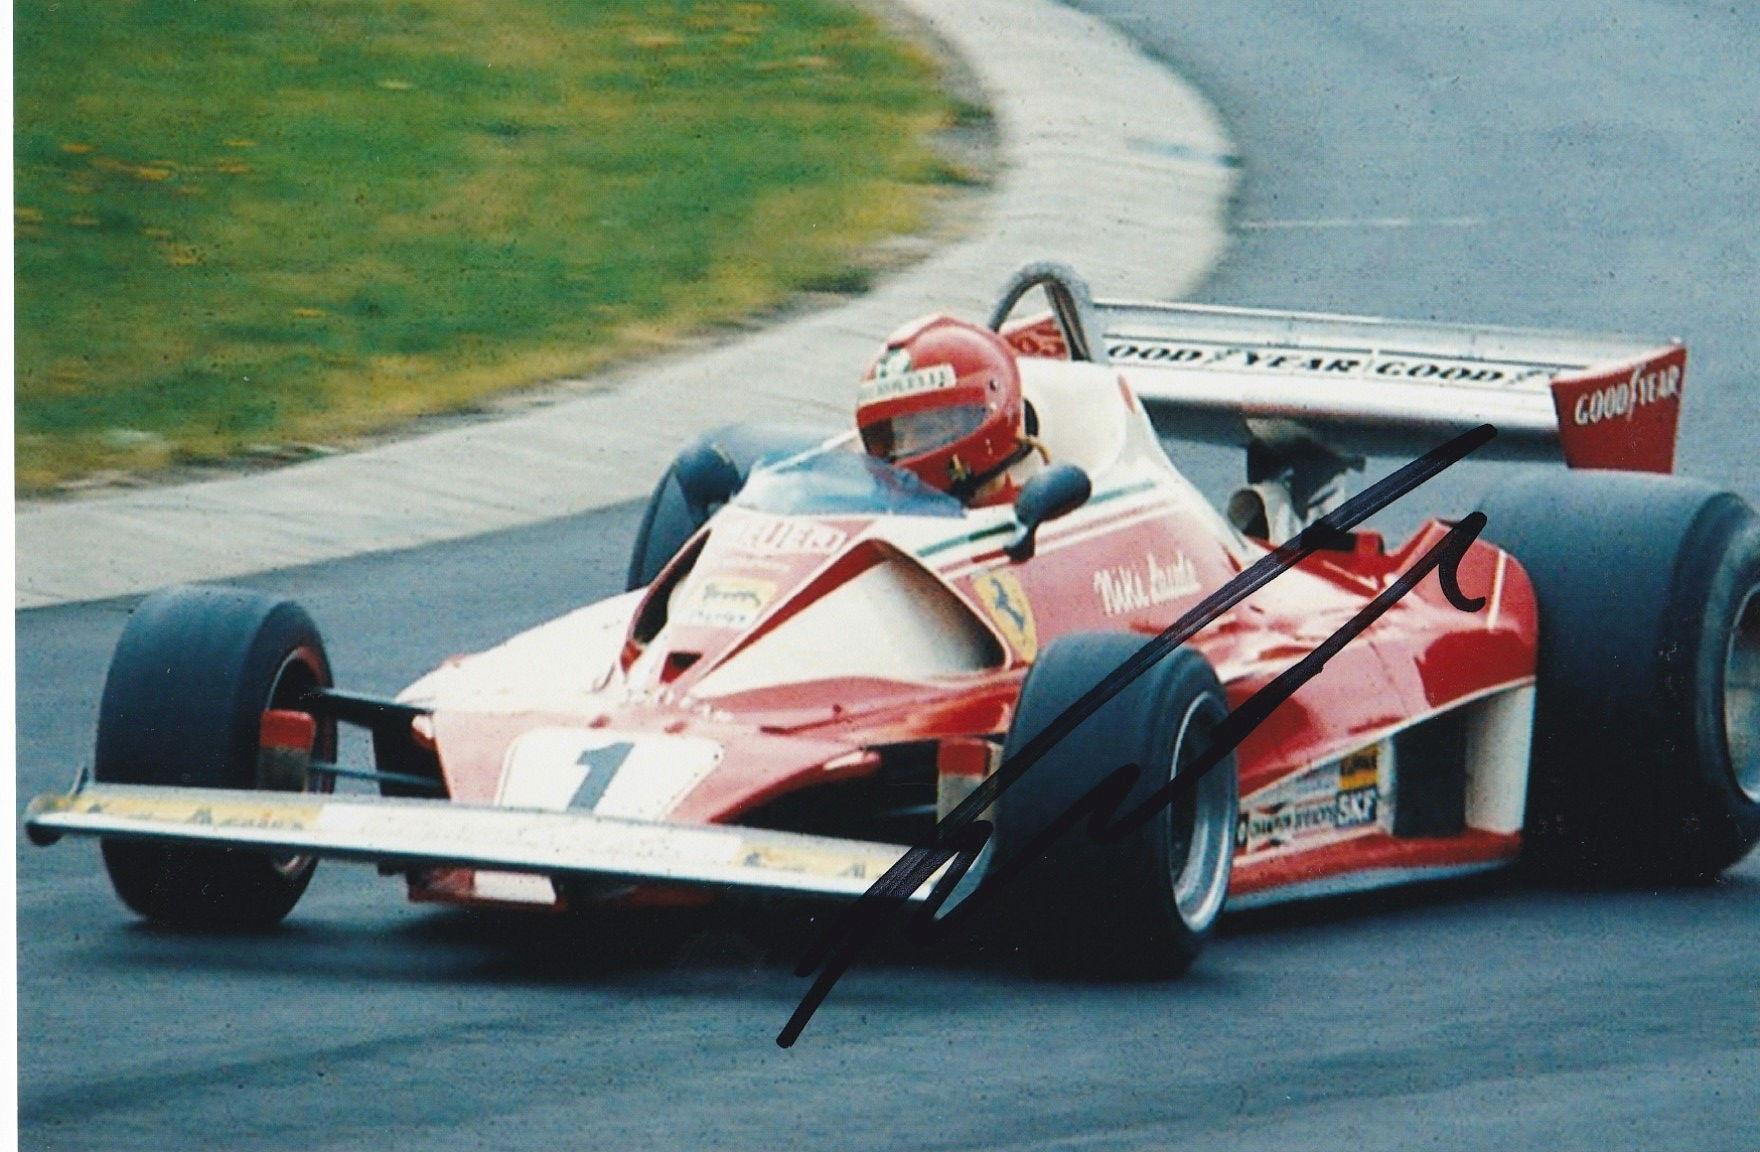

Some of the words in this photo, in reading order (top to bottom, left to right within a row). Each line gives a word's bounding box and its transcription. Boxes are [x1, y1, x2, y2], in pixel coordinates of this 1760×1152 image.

[1106, 344, 1203, 362] OOD
[1240, 350, 1360, 373] YEAR
[1375, 361, 1504, 382] GOOD
[565, 742, 636, 815] 1
